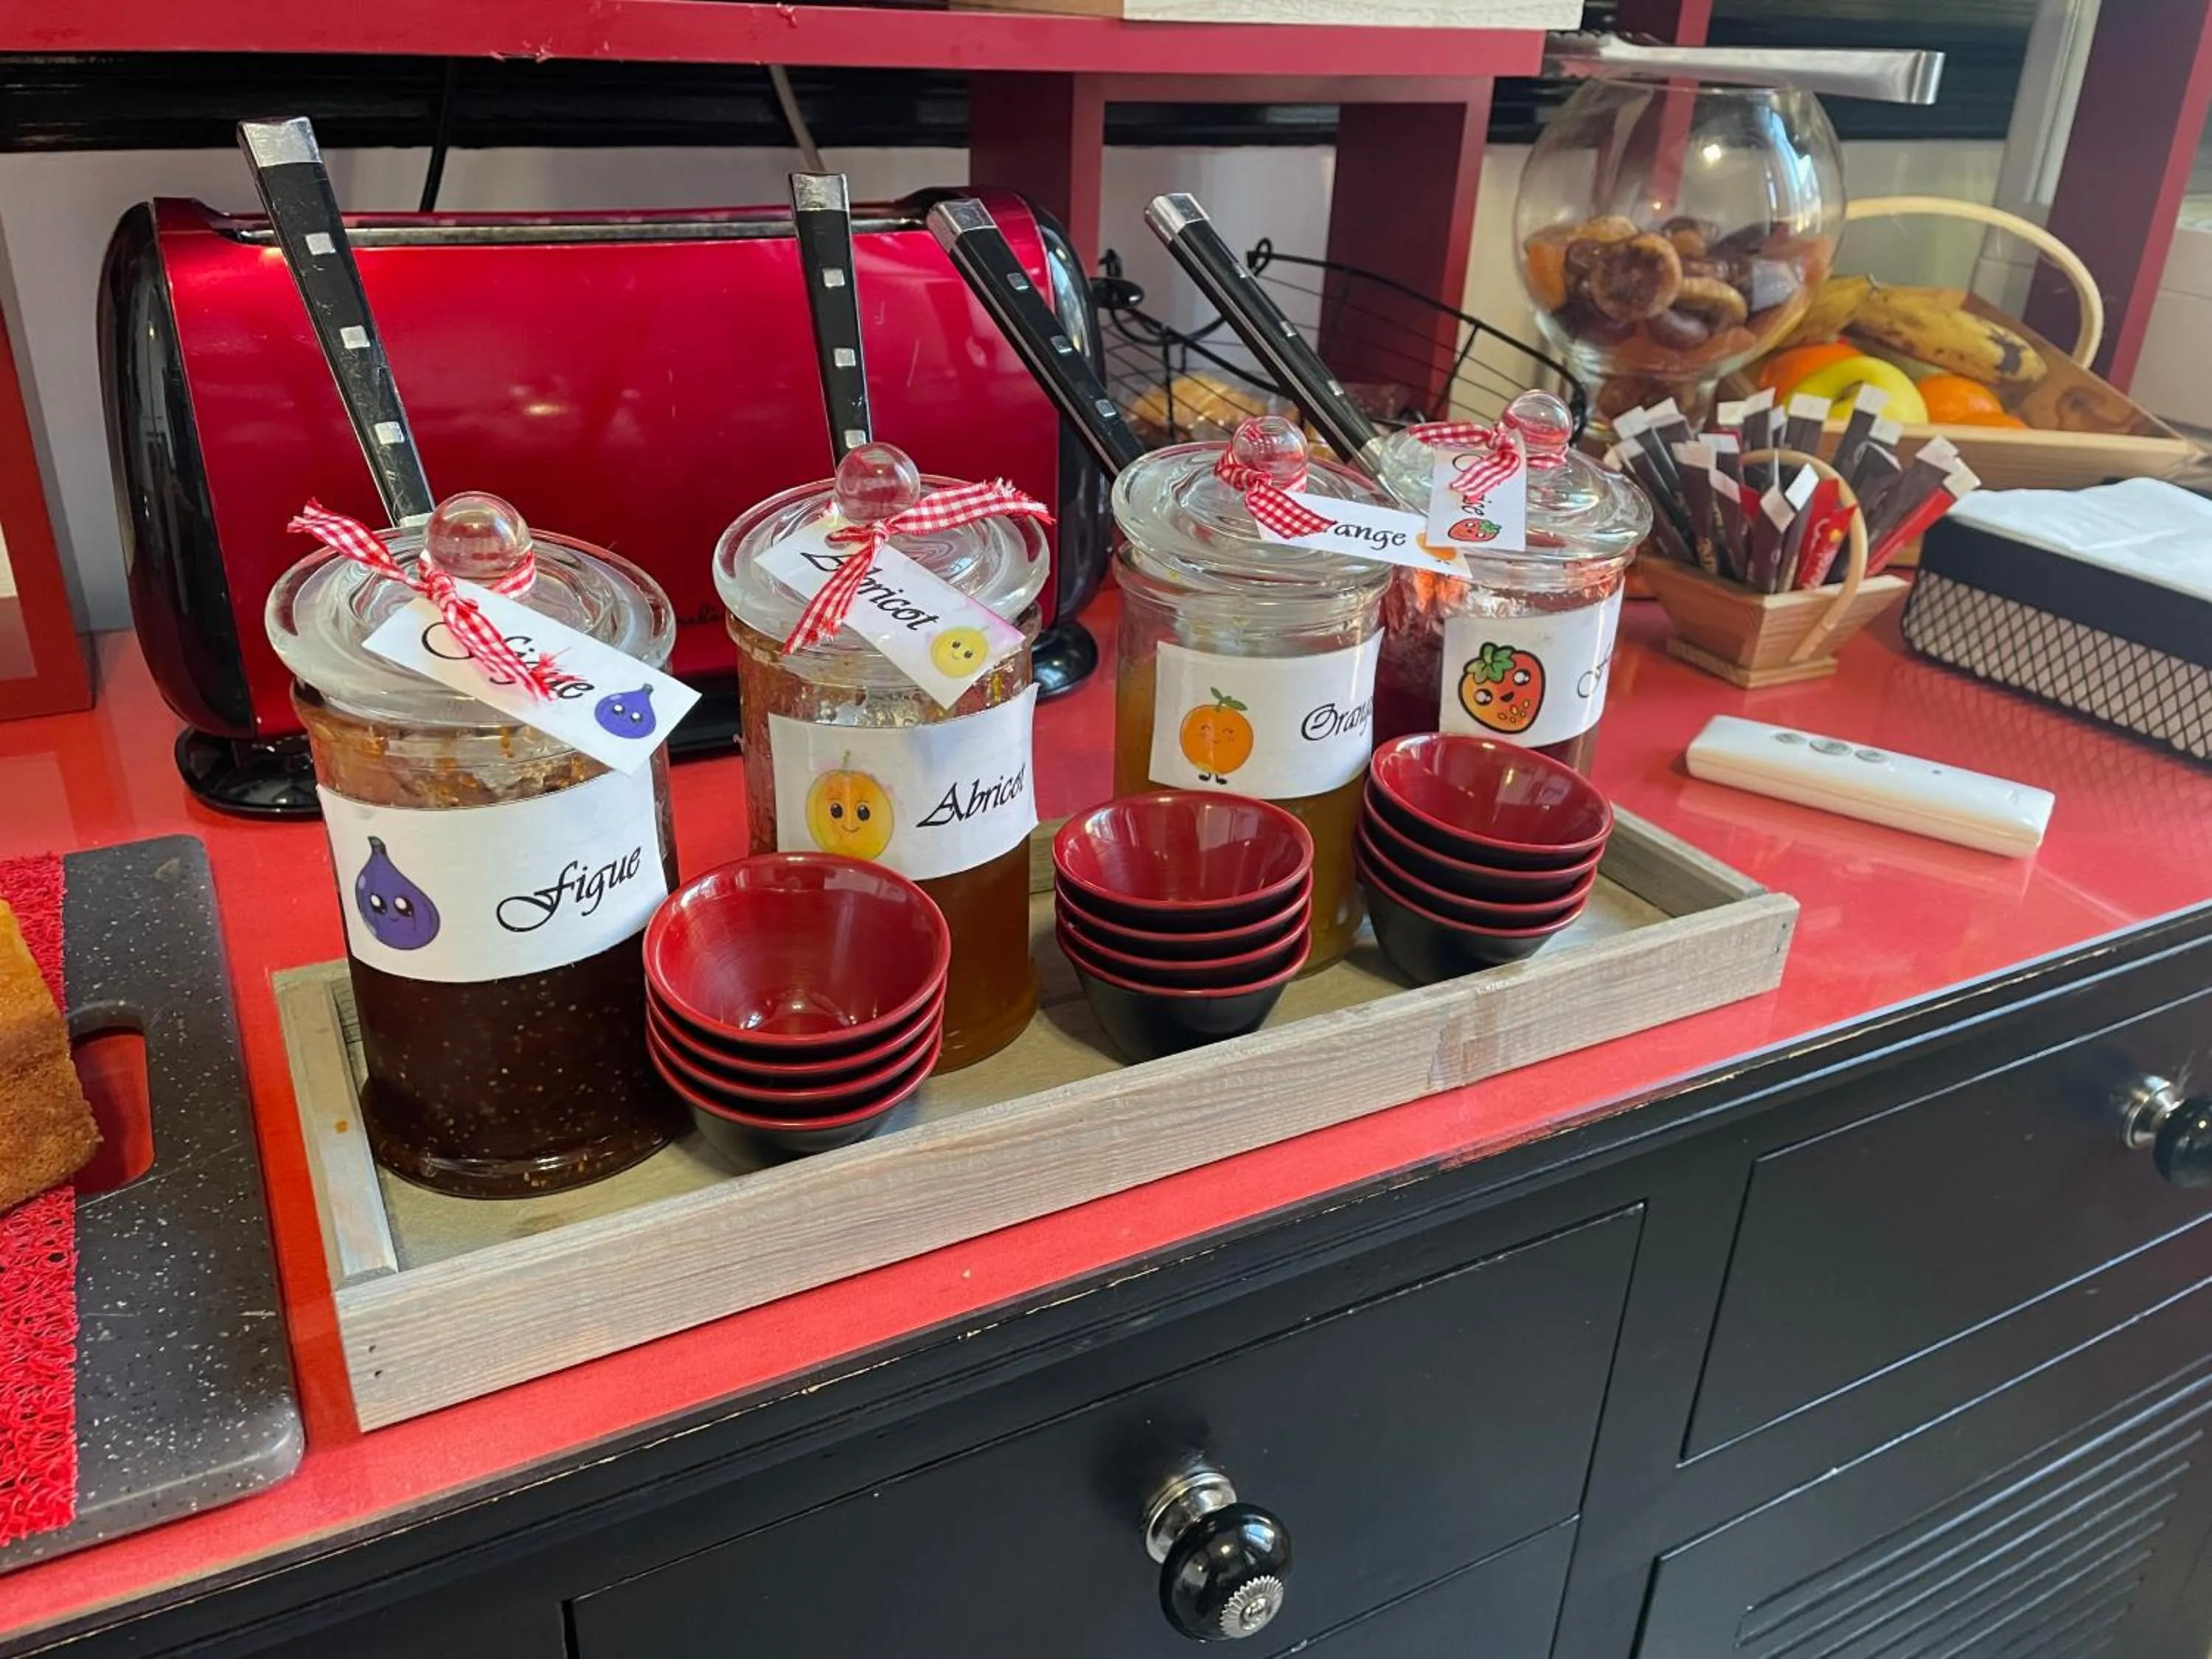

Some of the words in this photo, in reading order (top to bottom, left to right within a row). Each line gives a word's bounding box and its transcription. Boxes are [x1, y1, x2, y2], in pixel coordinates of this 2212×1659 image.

[1332, 523, 1407, 552] ange
[915, 761, 1026, 829] Abricot
[495, 846, 642, 933] Figue
